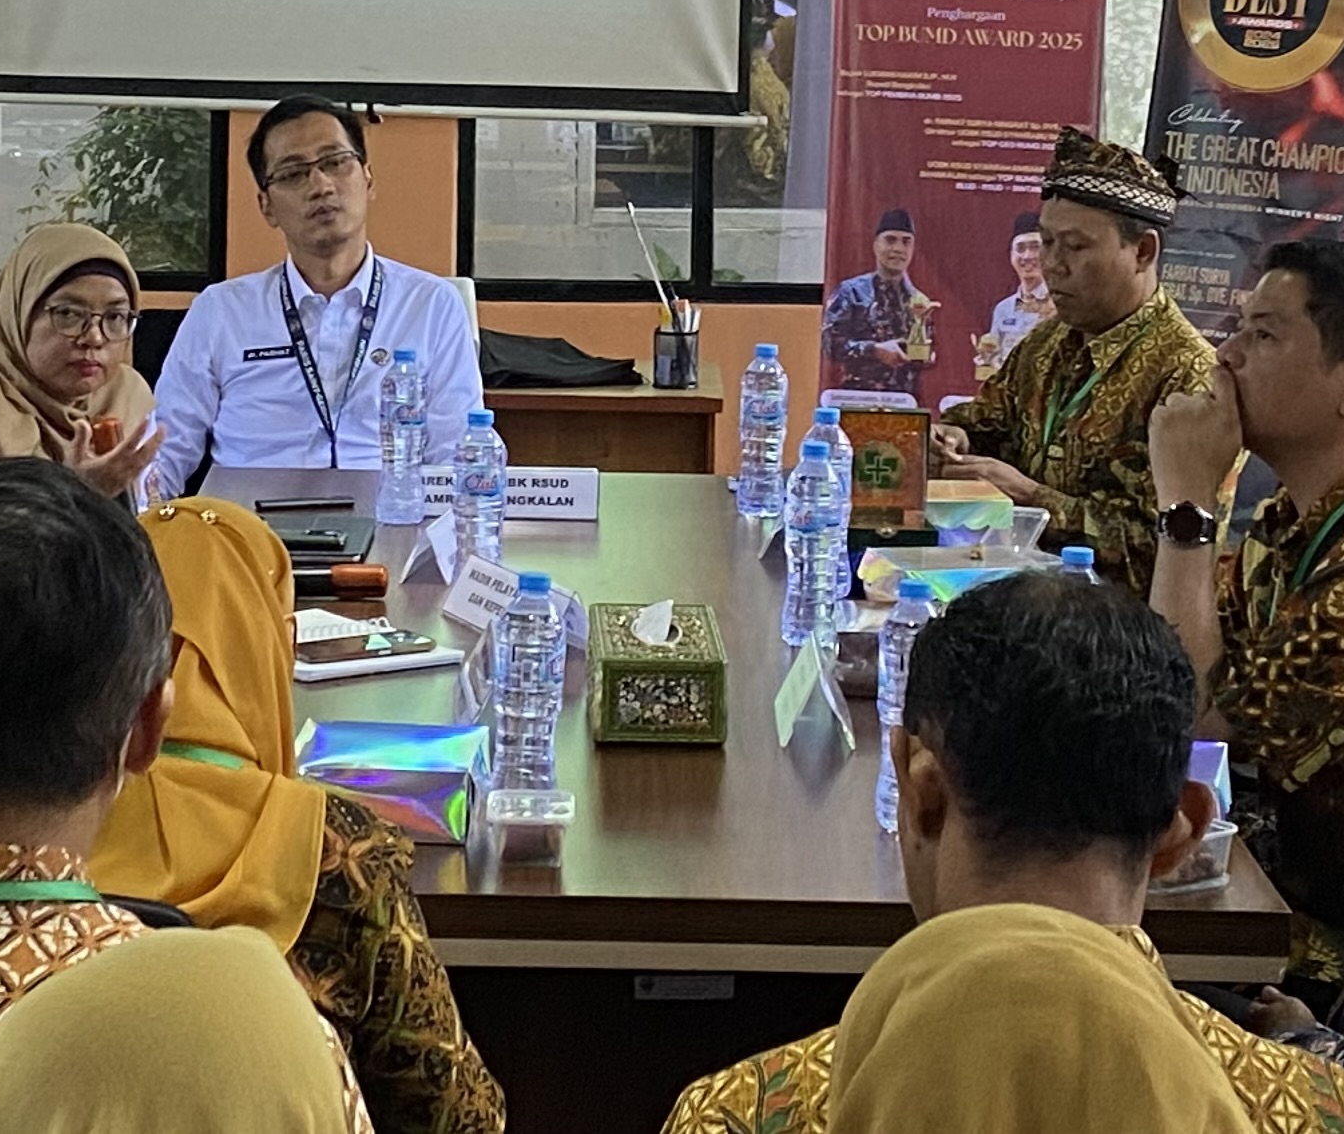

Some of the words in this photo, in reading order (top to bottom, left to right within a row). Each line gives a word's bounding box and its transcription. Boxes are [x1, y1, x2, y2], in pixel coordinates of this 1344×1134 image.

[927, 6, 1007, 23] Penghargaan
[1237, 17, 1293, 29] AWARDS
[855, 23, 896, 43] TOP
[898, 25, 958, 46] BUMD
[960, 28, 1035, 48] AWARD
[1037, 31, 1084, 51] 2025
[1166, 103, 1245, 134] Celebrating
[1164, 129, 1200, 162] THE
[1201, 133, 1261, 166] GREAT
[1186, 165, 1282, 201] INDONESIA
[1313, 212, 1344, 222] NIGHT
[507, 478, 528, 488] BK
[531, 478, 569, 489] RSUD
[507, 496, 575, 506] NGKALAN
